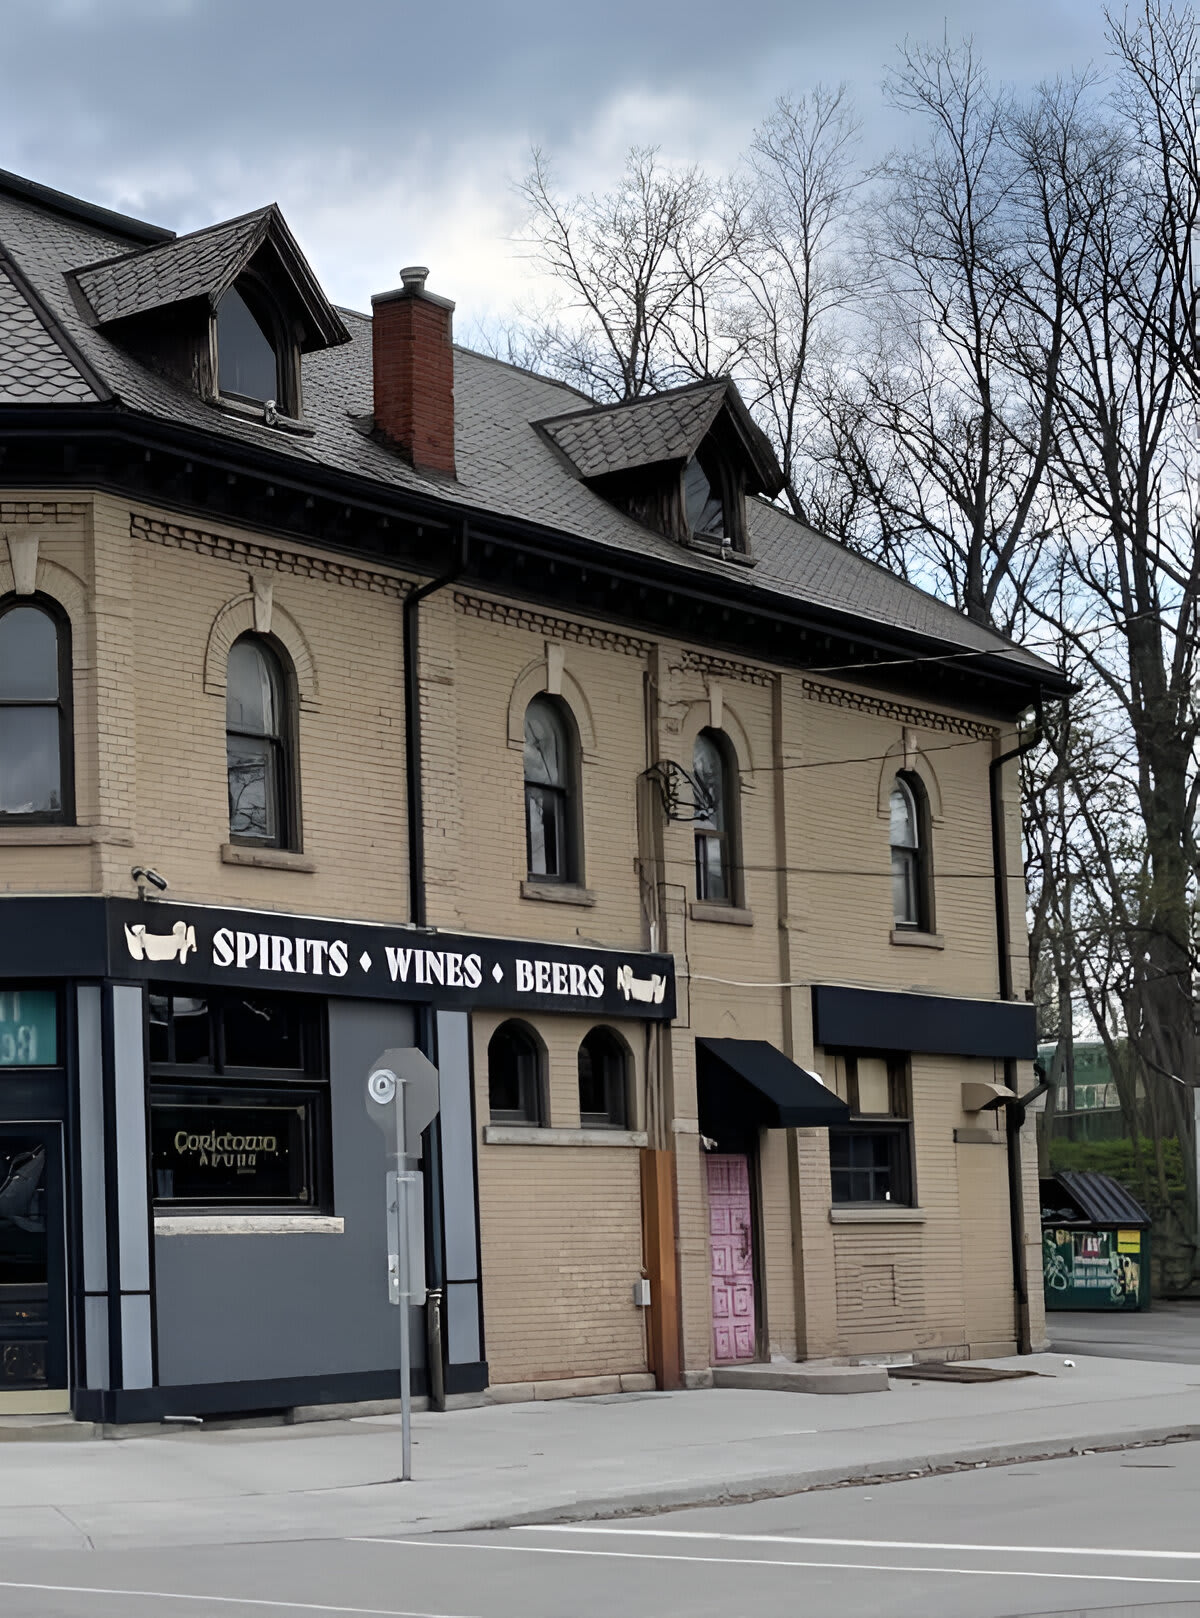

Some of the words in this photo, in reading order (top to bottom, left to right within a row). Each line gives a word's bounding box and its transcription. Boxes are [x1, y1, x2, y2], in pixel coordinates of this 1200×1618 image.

[212, 927, 349, 977] SPIRITS
[384, 946, 482, 988] WINES
[515, 959, 605, 998] BEERS
